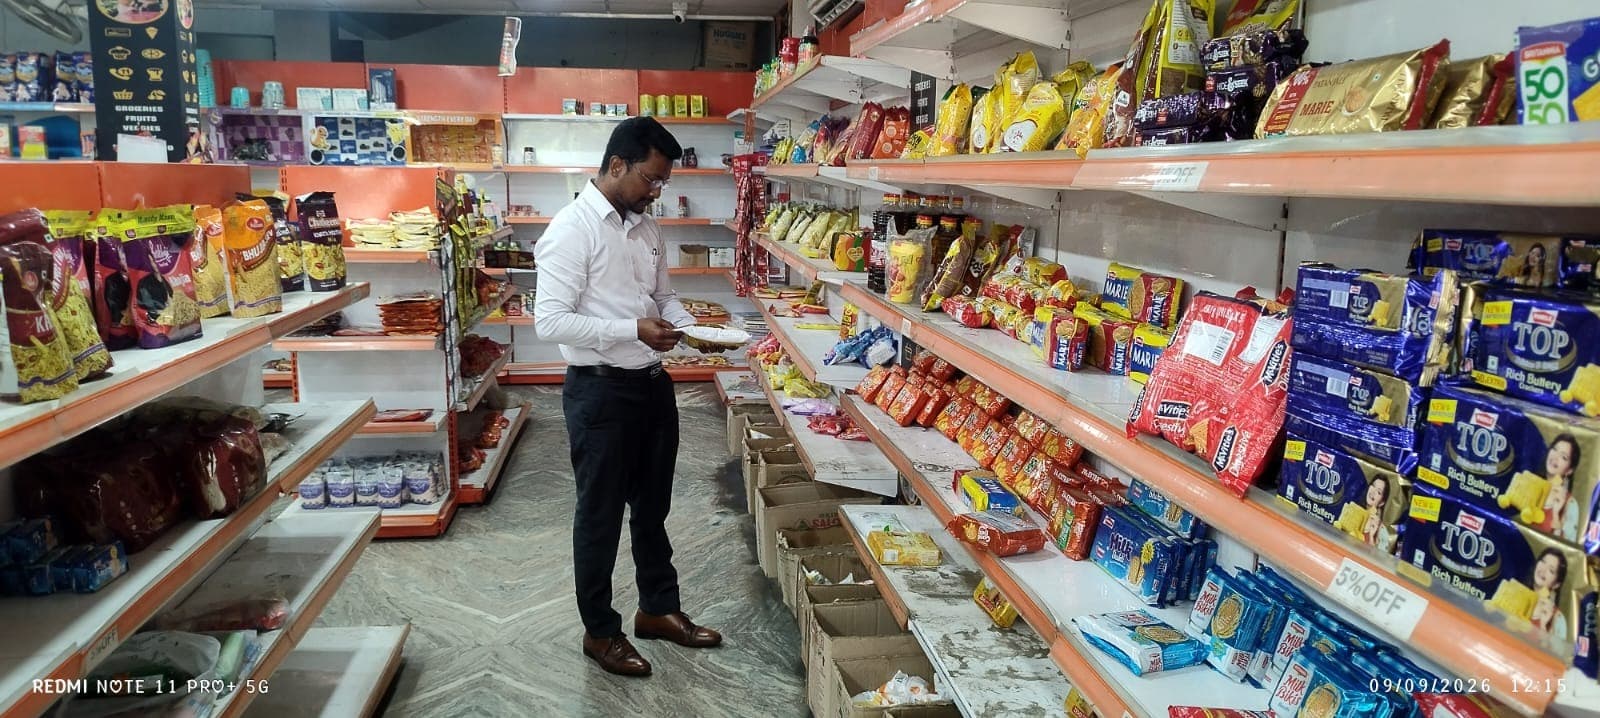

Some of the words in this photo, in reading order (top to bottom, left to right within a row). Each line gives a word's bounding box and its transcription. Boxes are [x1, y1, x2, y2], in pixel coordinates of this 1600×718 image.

[1524, 66, 1565, 102] 50
[115, 105, 164, 113] GROCERIES
[1300, 101, 1335, 116] MARIE
[1104, 280, 1129, 300] MARIE
[1058, 338, 1068, 367] MARIE
[1513, 321, 1569, 359] TOP
[1115, 343, 1126, 371] MARIE
[1505, 367, 1526, 382] Rich
[1527, 373, 1562, 395] Buttery
[1457, 421, 1507, 462] TOP
[1305, 460, 1341, 495] TOP
[1447, 466, 1466, 483] Rich
[1467, 474, 1499, 499] Buttery
[1312, 503, 1335, 523] Buttery
[1110, 532, 1134, 555] Milk
[1440, 521, 1495, 567] TOP
[1201, 590, 1217, 604] Milk
[1335, 566, 1407, 615] 5%OFF
[1431, 565, 1452, 581] Rich
[1452, 575, 1486, 601] Buttery
[1276, 686, 1302, 706] Bikis
[1284, 674, 1307, 696] Milk
